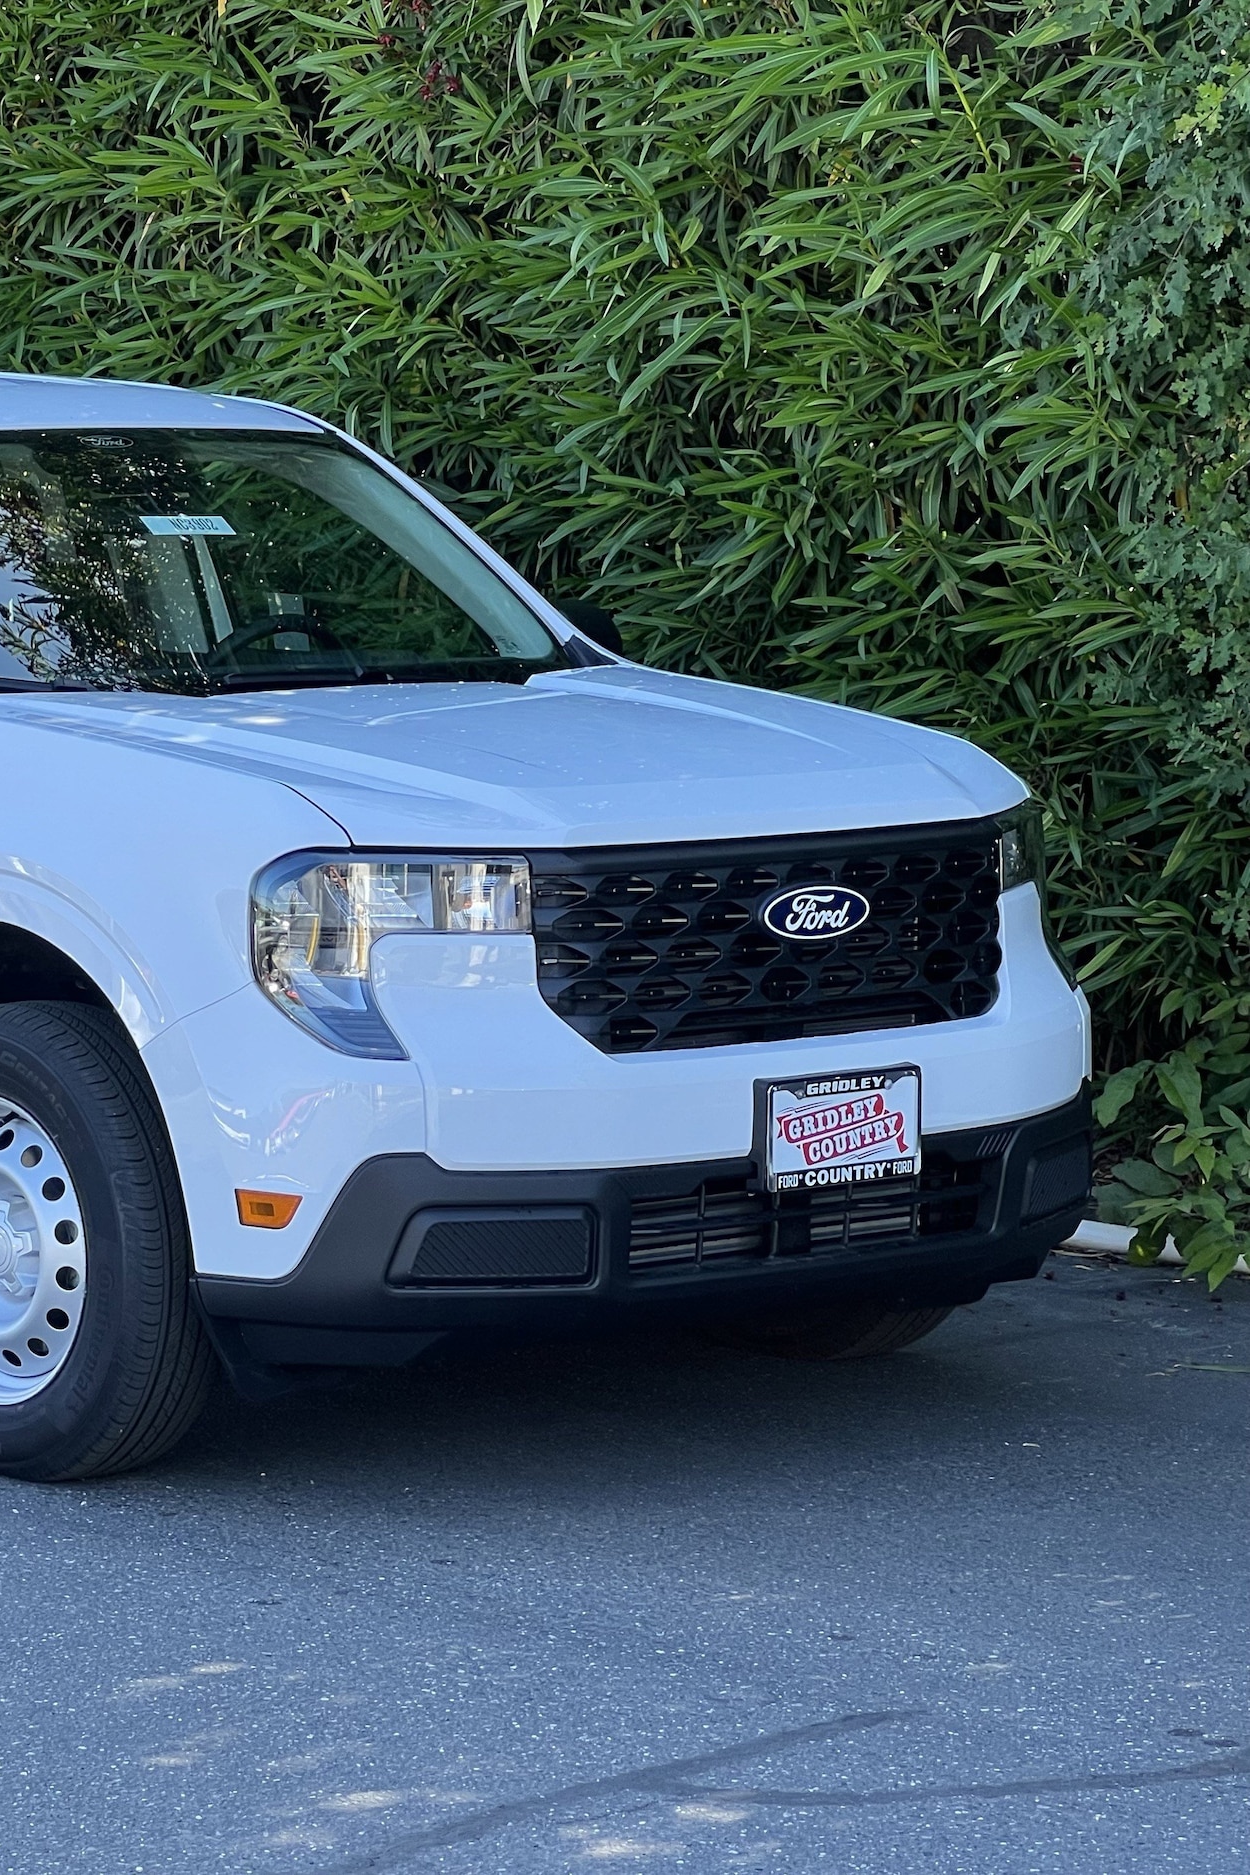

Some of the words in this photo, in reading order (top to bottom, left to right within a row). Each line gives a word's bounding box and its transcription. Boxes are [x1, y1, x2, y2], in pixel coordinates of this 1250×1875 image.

[785, 894, 850, 931] Ford
[806, 1076, 884, 1095] GRIDLEY
[788, 1097, 878, 1140] GRIDLEY
[808, 1115, 898, 1163] COUNTRY
[778, 1174, 799, 1189] FORD
[804, 1163, 888, 1187] COUNTRY
[892, 1160, 913, 1175] FORD
